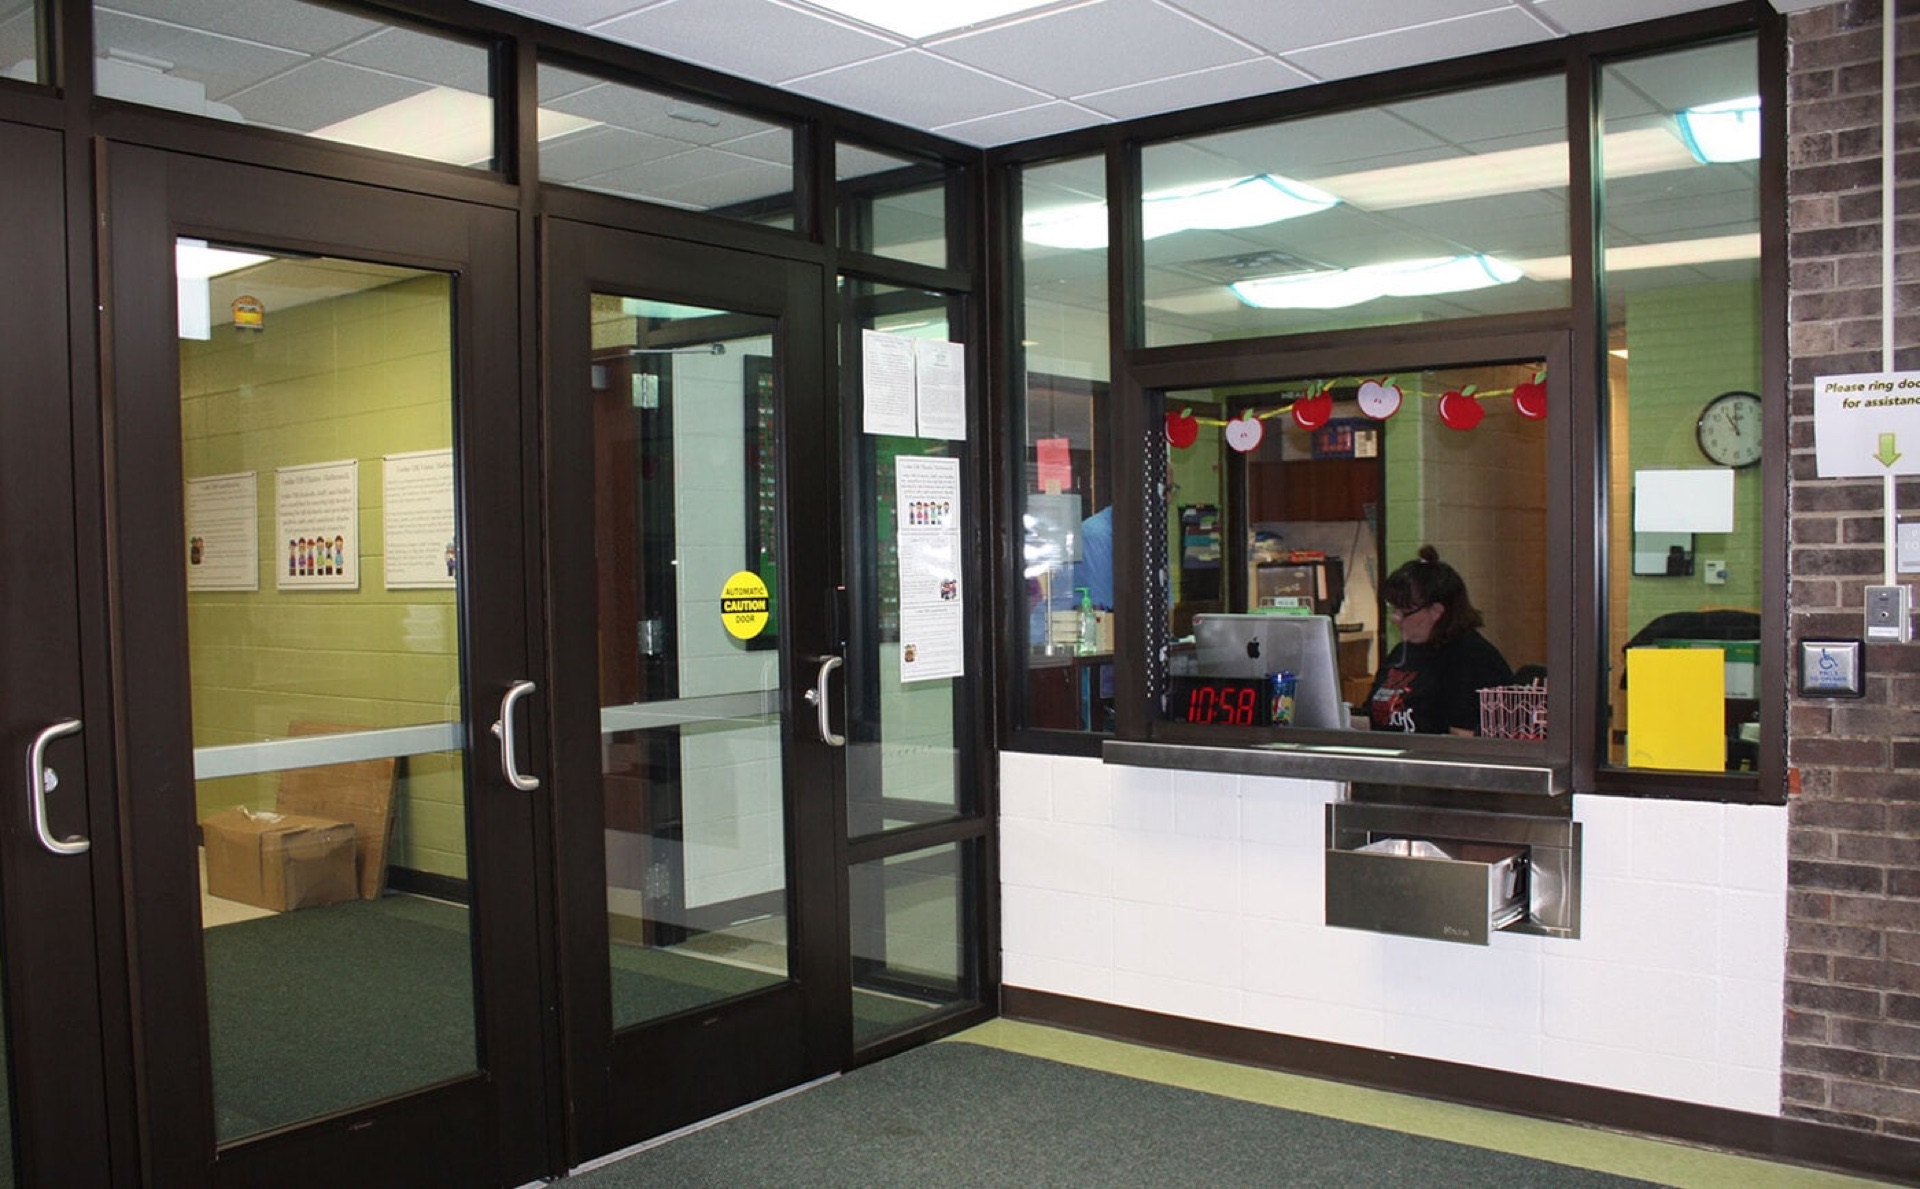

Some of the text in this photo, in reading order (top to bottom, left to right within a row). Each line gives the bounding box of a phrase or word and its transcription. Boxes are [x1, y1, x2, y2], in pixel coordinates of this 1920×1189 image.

[1825, 382, 1865, 393] Please
[1868, 380, 1894, 392] ring
[1842, 398, 1861, 409] for
[726, 587, 764, 595] AUTOMATIC
[723, 600, 766, 611] CAUTION
[736, 614, 755, 623] DOOR
[1187, 686, 1256, 725] 10:58
